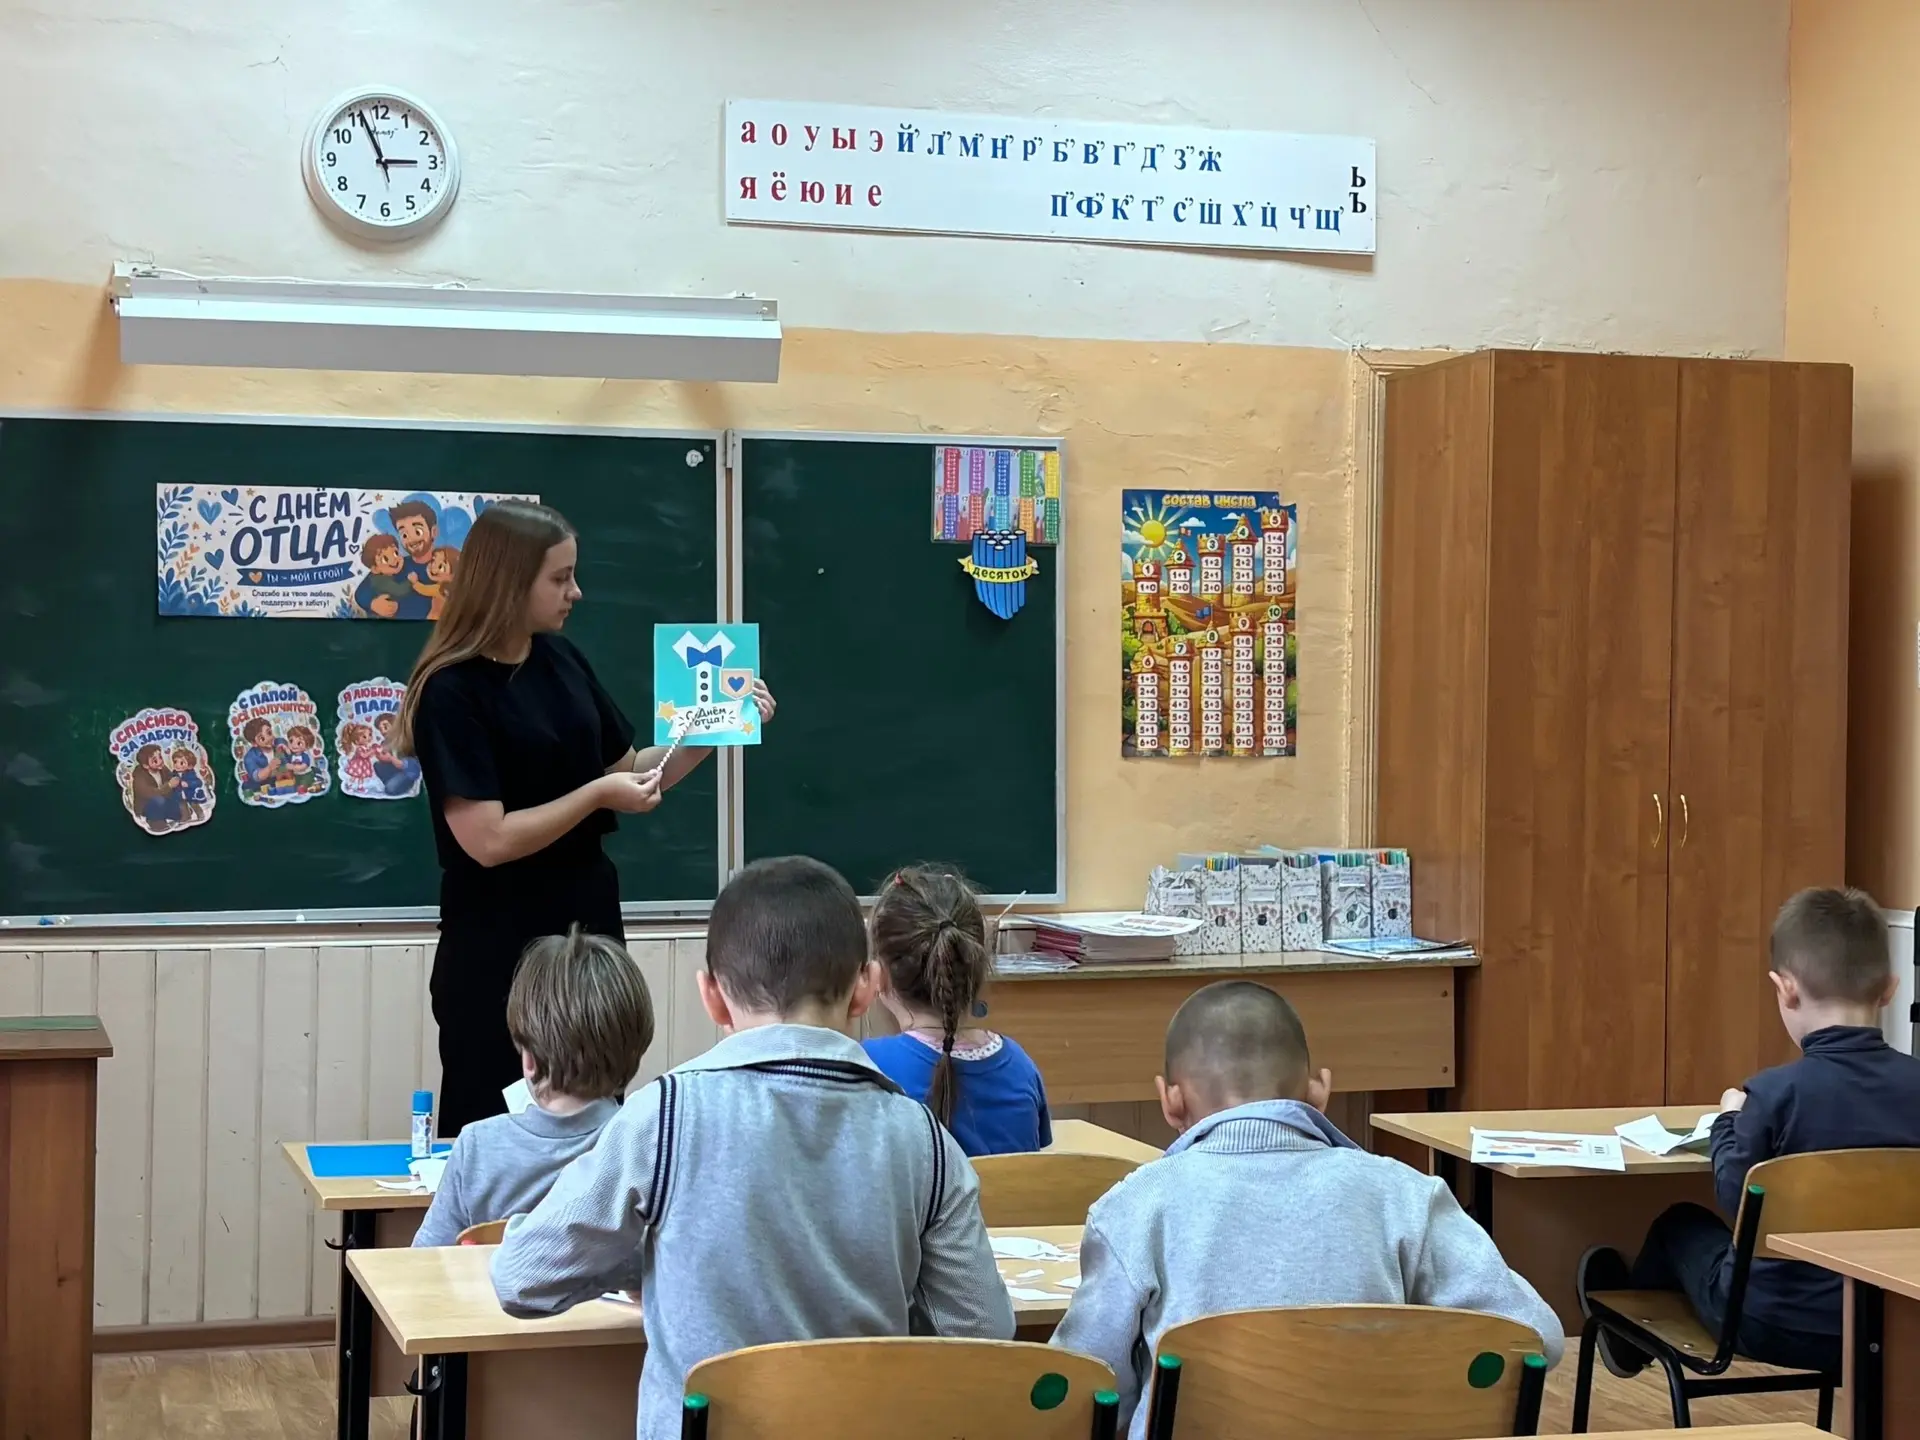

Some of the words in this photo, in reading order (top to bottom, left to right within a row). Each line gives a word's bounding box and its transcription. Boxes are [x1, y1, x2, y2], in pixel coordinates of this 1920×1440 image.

[372, 105, 390, 120] 12
[401, 114, 408, 128] 1
[333, 128, 351, 144] 10
[419, 131, 429, 145] 2
[327, 152, 336, 167] 9
[428, 155, 438, 170] 3
[338, 176, 348, 191] 8
[420, 178, 431, 193] 4
[356, 194, 366, 209] 7
[406, 195, 415, 210] 5
[381, 202, 390, 217] 6
[249, 495, 267, 523] С
[274, 487, 351, 525] ДНЁМ
[1272, 515, 1278, 524] 5
[1239, 527, 1246, 536] 4
[230, 517, 362, 566] ОТЦА!
[1210, 540, 1215, 548] 3
[1177, 552, 1182, 561] 2
[266, 574, 279, 583] ТЫ
[290, 570, 310, 582] МОЙ
[313, 567, 344, 580] ГЕРОЙ!
[1145, 564, 1150, 573] 1
[1269, 608, 1279, 616] 10
[1241, 620, 1246, 628] 9
[1178, 645, 1184, 653] 7
[1145, 658, 1150, 666] 6
[239, 698, 248, 709] С
[250, 687, 297, 706] ПАПОЙ
[344, 691, 352, 702] Я
[354, 688, 393, 699] ЛЮБЛЮ
[251, 703, 313, 717] ПОЛУЧИТСЯ!
[116, 714, 187, 743] СПАСИБО
[121, 740, 139, 757] ЗА
[139, 729, 191, 745] ЗАБОТУ!
